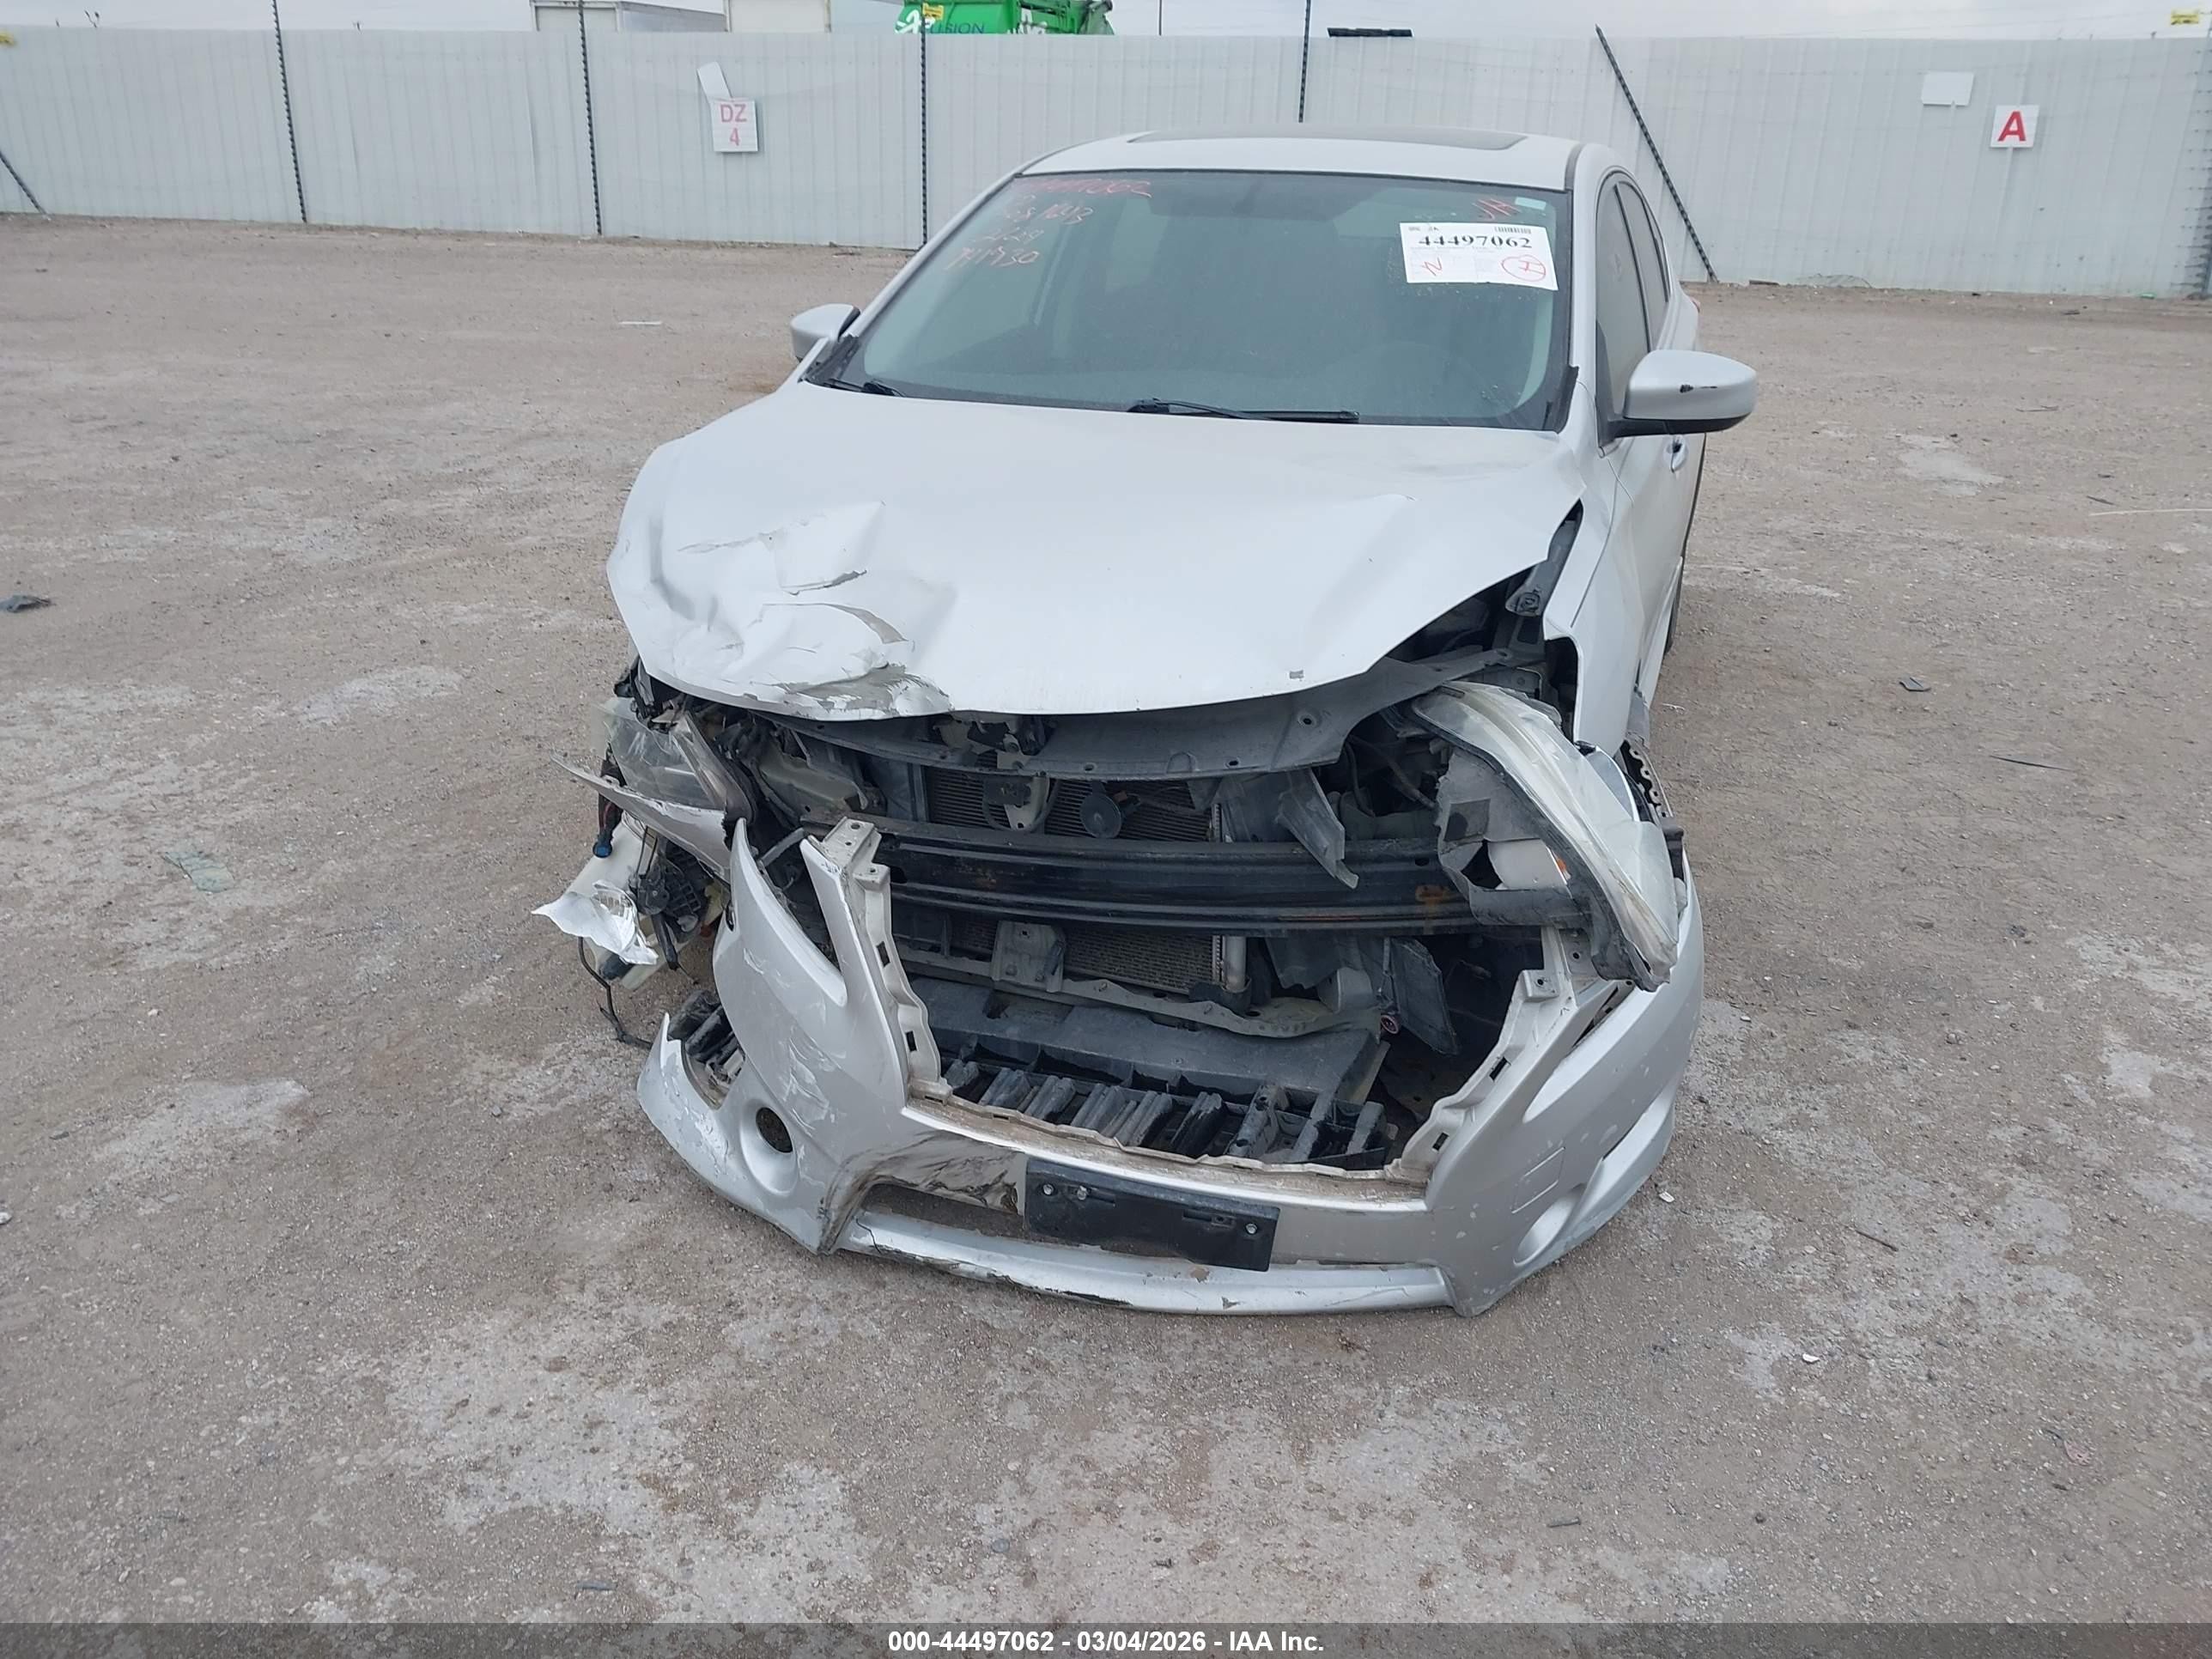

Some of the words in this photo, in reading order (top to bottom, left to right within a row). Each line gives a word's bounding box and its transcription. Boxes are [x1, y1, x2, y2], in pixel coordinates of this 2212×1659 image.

[720, 103, 749, 124] DZ
[1998, 111, 2027, 142] A
[729, 127, 741, 147] 4
[1419, 234, 1533, 249] 44497062
